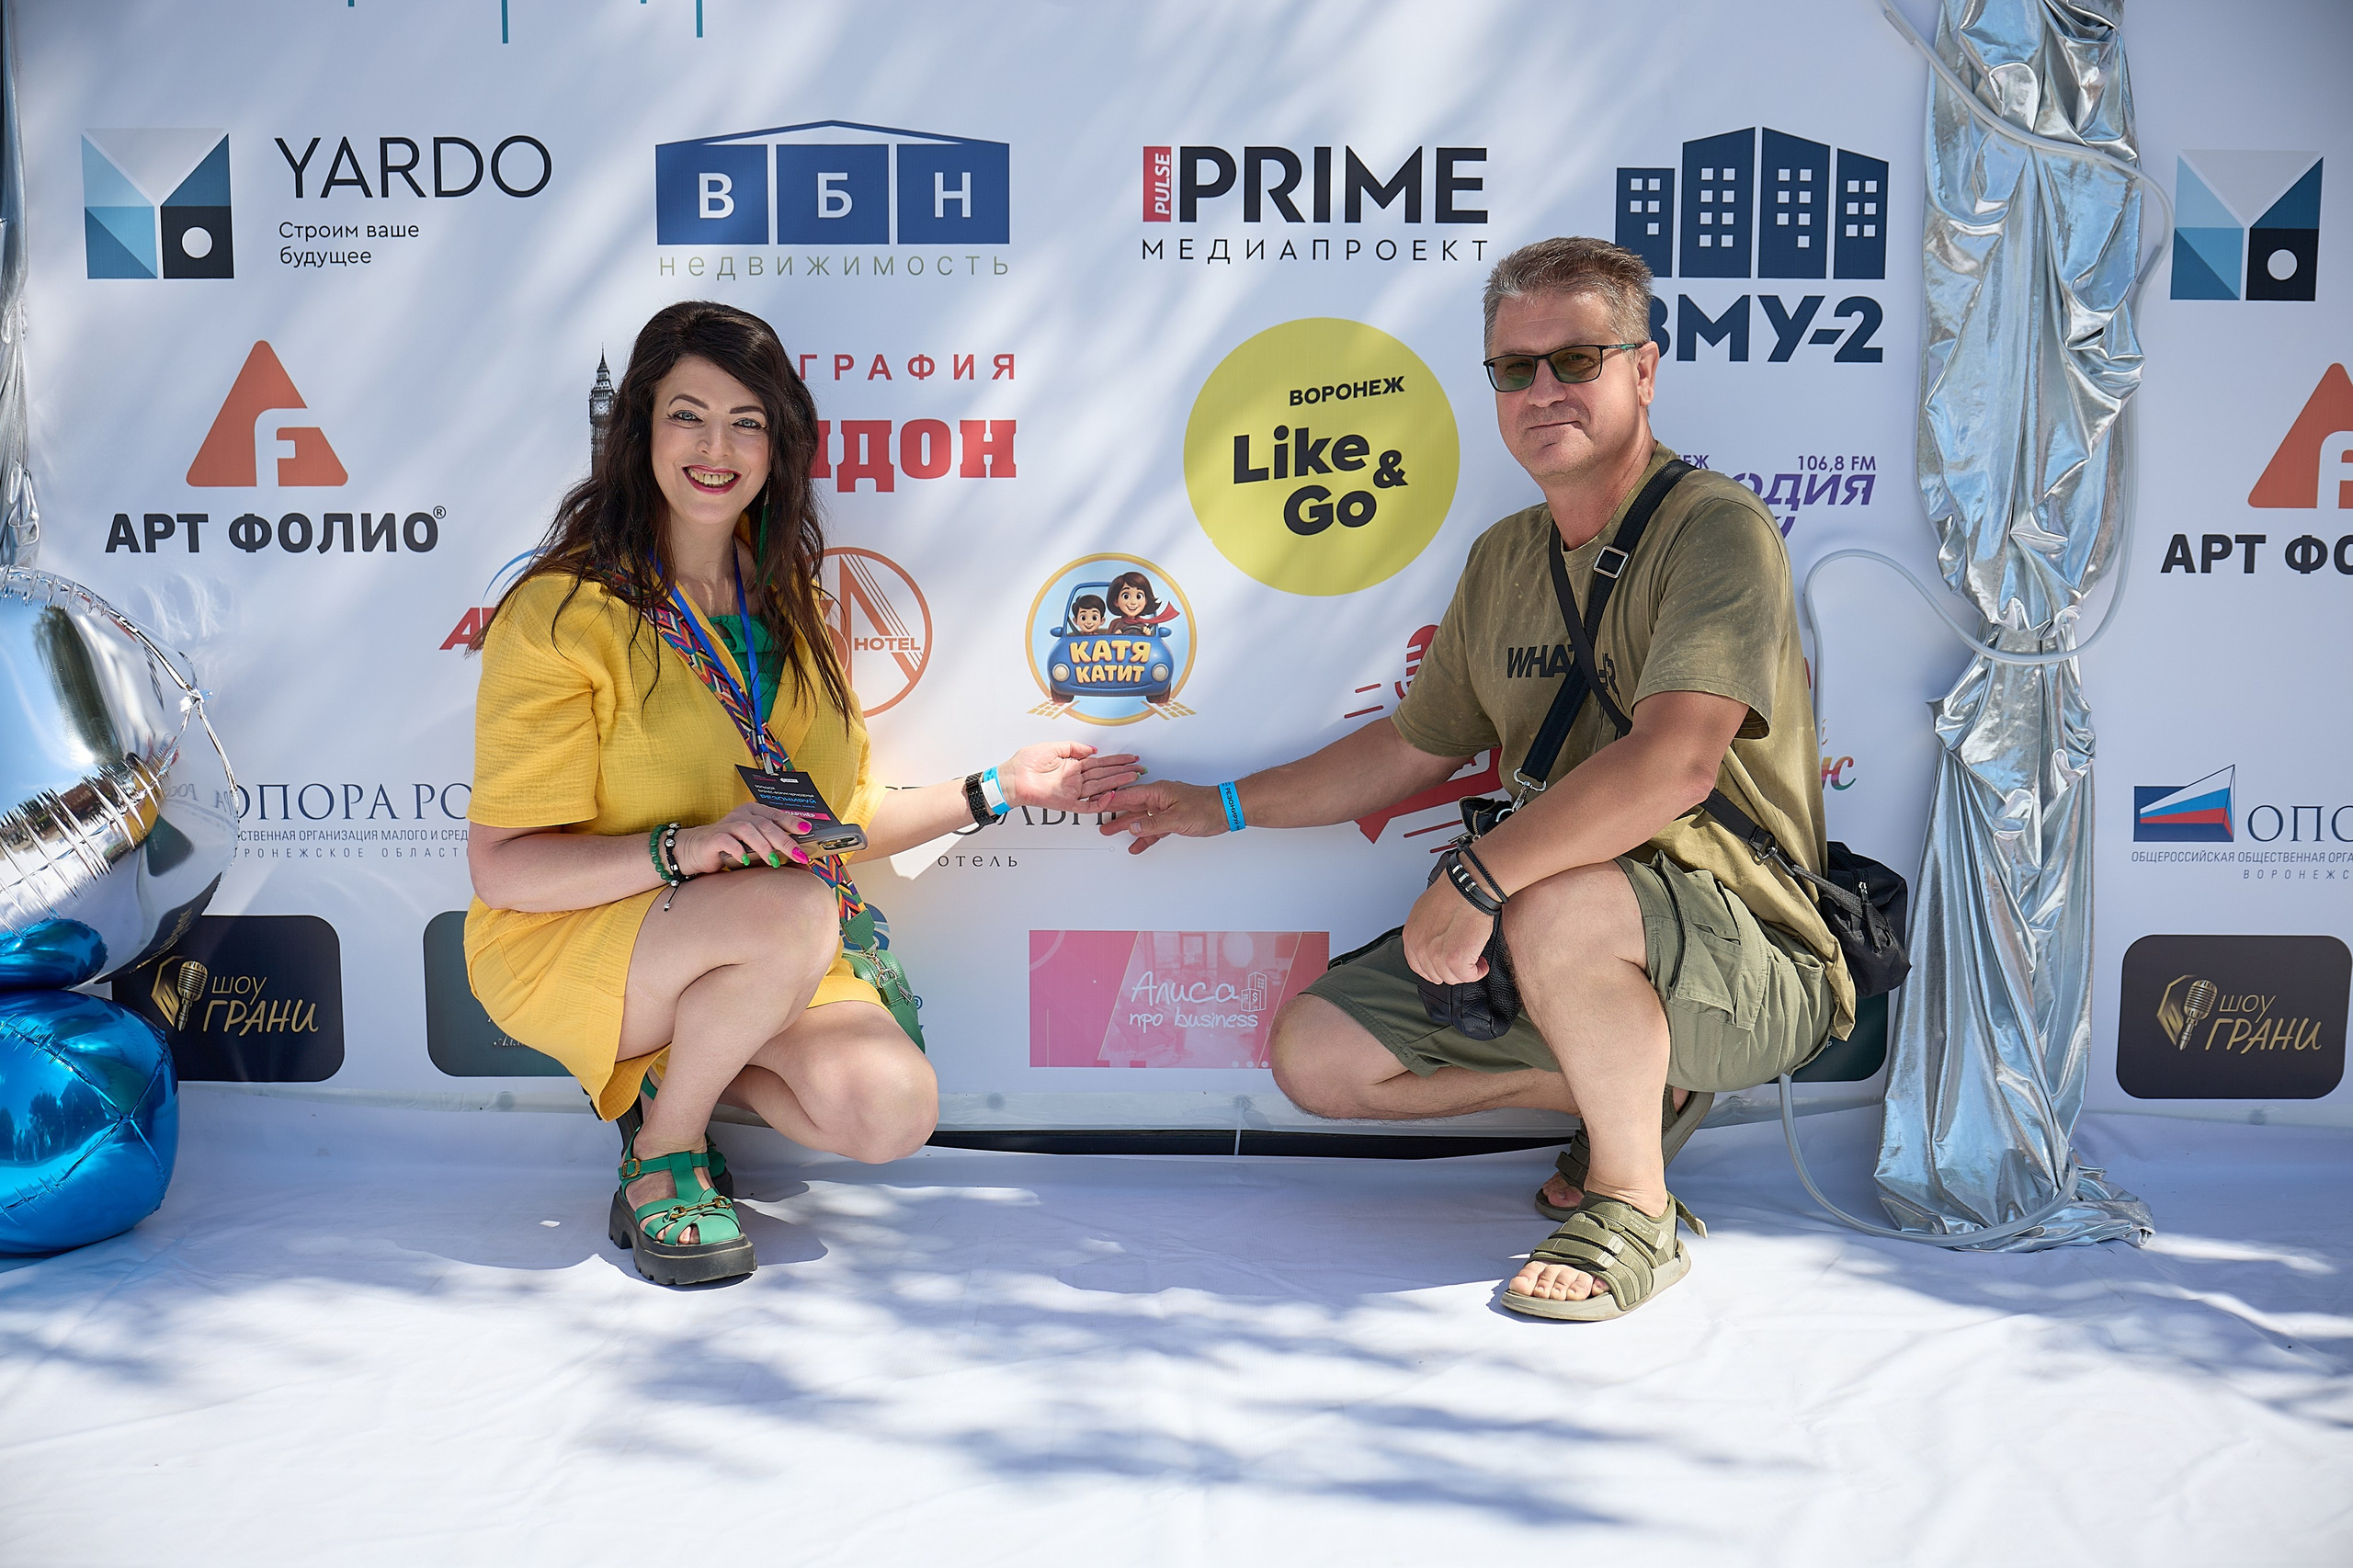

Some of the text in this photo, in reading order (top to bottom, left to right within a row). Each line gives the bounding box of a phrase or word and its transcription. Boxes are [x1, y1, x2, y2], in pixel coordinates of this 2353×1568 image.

[274, 135, 552, 199] YARDO
[1154, 153, 1171, 216] PULSE
[1179, 145, 1489, 223] PRIME
[278, 222, 419, 241] Строим ваше
[279, 246, 371, 267] будущее
[1142, 239, 1488, 265] МЕДИАПРОЕКТ
[659, 256, 1009, 280] недвижимость
[799, 353, 1015, 381] ГРАФИЯ
[1289, 375, 1405, 406] ВОРОНЕЖ
[1233, 425, 1408, 489] Like &
[1798, 456, 1845, 472] 106,8
[1851, 456, 1877, 471] FM
[1732, 472, 1876, 511] ОДИЯ
[1283, 484, 1377, 536] Go
[105, 513, 209, 553] АРТ
[2160, 533, 2267, 574] АРТ
[854, 638, 921, 651] HOTEL
[1070, 640, 1152, 664] КАТЯ
[1075, 665, 1145, 684] КАТИТ
[412, 783, 472, 820] РО
[1225, 787, 1241, 825] РЕЗОНИРУЙ
[239, 830, 469, 843] СТВЕННАЯ ОРГАНИЗАЦИЯ МАЛОГО И СРЕД
[381, 848, 469, 858] ОБЛАСТ
[938, 855, 1018, 868] отель
[2131, 850, 2235, 864] ОБЩЕРОССИЙСКАЯ
[2237, 851, 2325, 864] ОБЩЕСТВЕННАЯ
[2243, 869, 2349, 880] ВОРОНЕЖС
[211, 975, 267, 1005] ШОУ
[1131, 971, 1239, 1006] Алиса
[202, 998, 319, 1037] ГРАНИ
[1130, 1006, 1258, 1034] про business
[2219, 994, 2277, 1023] ШОУ
[2206, 1017, 2323, 1054] ГРАНИ
